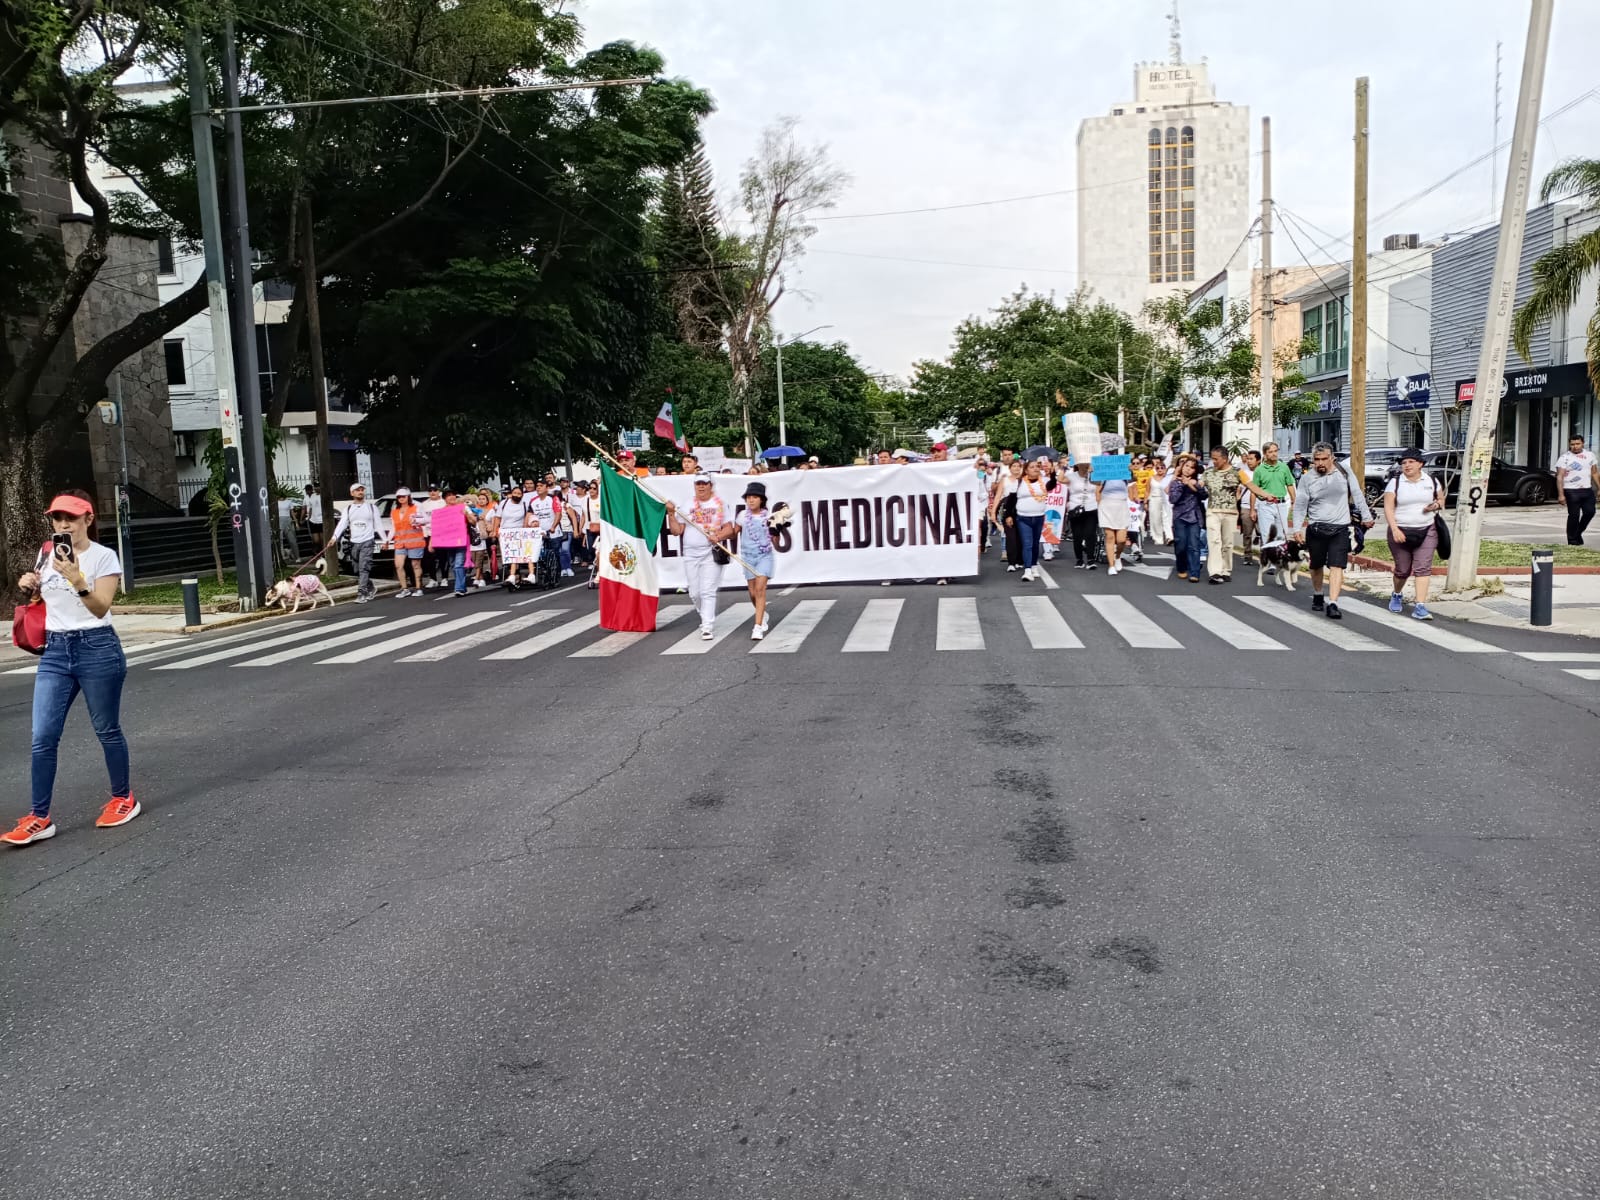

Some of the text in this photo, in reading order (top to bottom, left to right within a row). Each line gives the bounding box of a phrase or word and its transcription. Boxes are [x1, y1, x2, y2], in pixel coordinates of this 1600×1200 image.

[1149, 70, 1192, 82] HOTEL
[1515, 373, 1547, 388] BRIXTON
[801, 491, 973, 551] MEDICINA!
